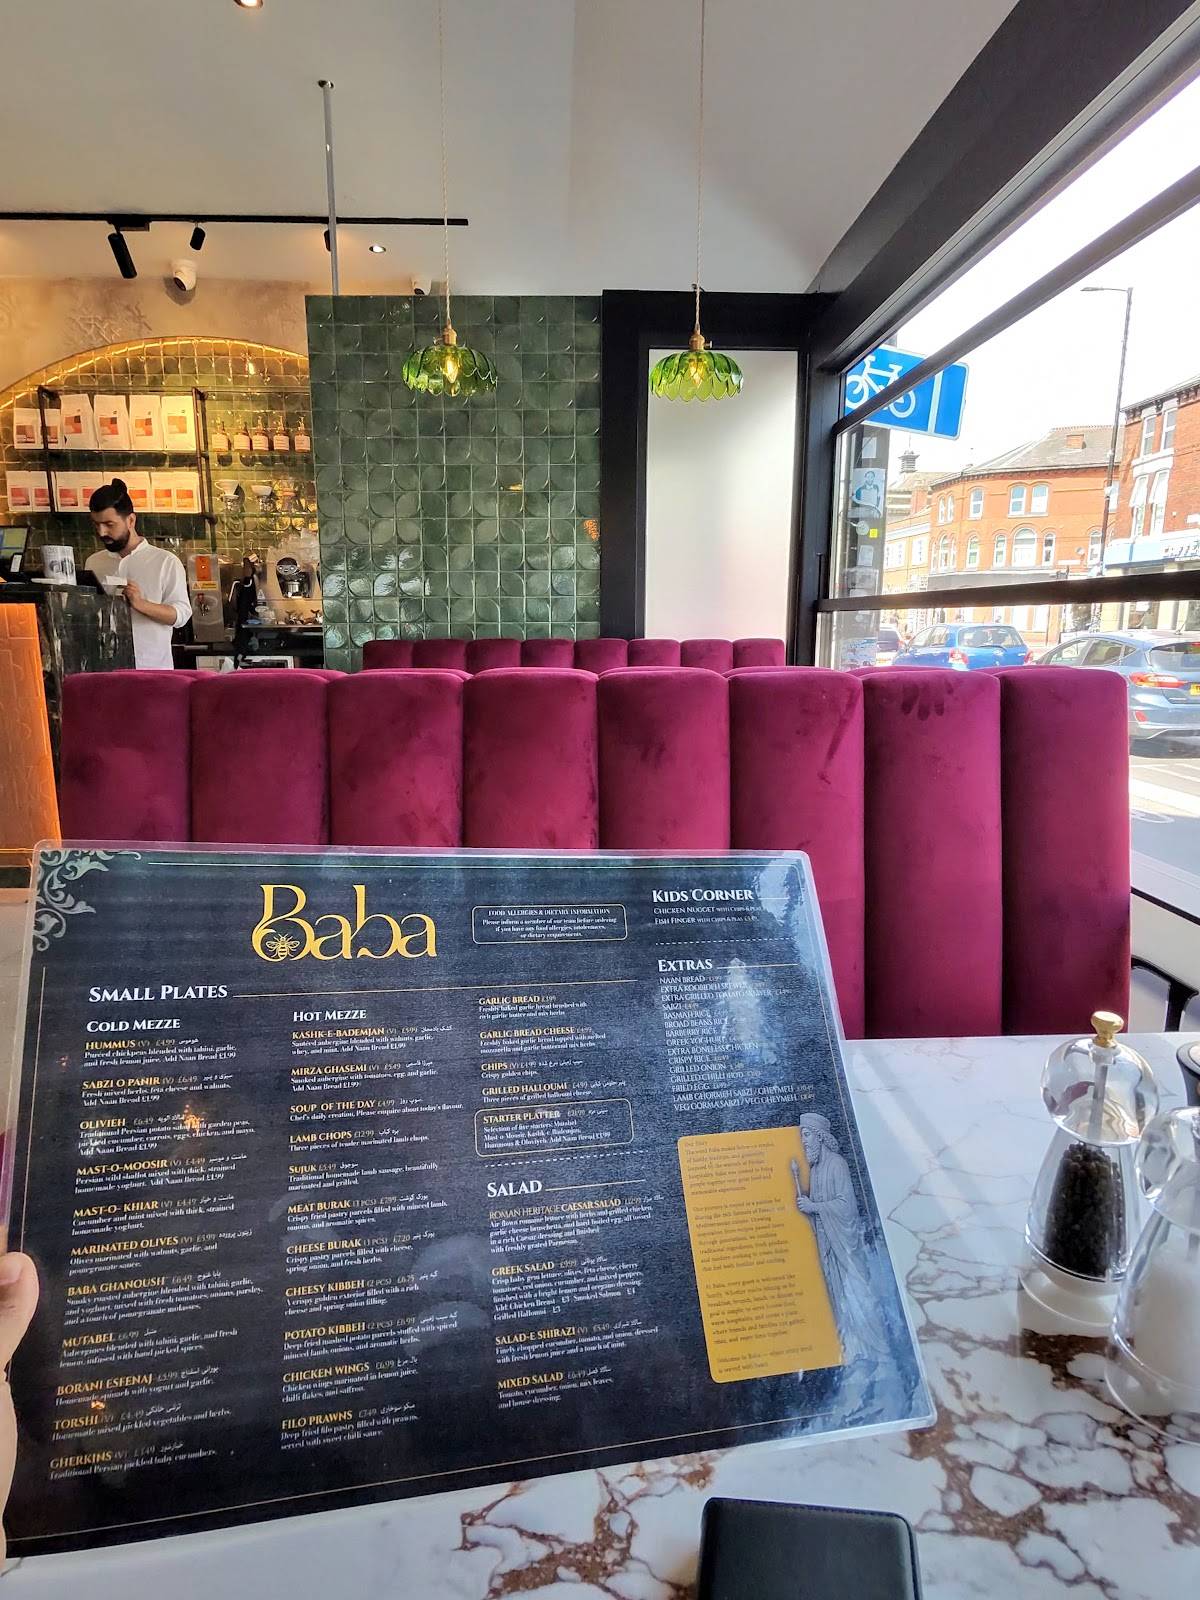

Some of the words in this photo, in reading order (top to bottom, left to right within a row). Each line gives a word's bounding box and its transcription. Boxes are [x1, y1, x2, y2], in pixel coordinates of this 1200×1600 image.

[652, 890, 688, 902] KIDS
[692, 889, 754, 901] CORNER
[251, 884, 437, 961] Baba
[658, 959, 712, 972] EXTRAS
[88, 986, 154, 1002] SMALL
[160, 984, 227, 999] PLATES
[293, 1012, 322, 1022] HOT
[325, 1010, 366, 1020] MEZZE
[87, 1021, 129, 1032] COLD
[133, 1019, 180, 1029] MEZZE
[480, 1031, 512, 1039] GARLIC
[514, 1029, 542, 1037] BREAD
[543, 1027, 575, 1035] CHEESE
[292, 1028, 384, 1039] KASHK-E-BADEMJAN
[85, 1040, 135, 1049] HUMMUS
[291, 1065, 322, 1076] MIRZA
[325, 1064, 367, 1074] GHASEMI
[481, 1063, 507, 1071] CHIPS
[83, 1080, 113, 1090] SABZI
[116, 1079, 125, 1087] O
[128, 1077, 160, 1086] PANIR
[482, 1086, 520, 1096] GRILLED
[521, 1082, 567, 1093] HALLOUMI
[290, 1104, 317, 1113] SOUP
[321, 1102, 334, 1111] OF
[336, 1101, 354, 1110] THE
[358, 1100, 375, 1108] DAY
[79, 1119, 126, 1130] OLIVIEH
[483, 1113, 522, 1124] STARTER
[523, 1110, 561, 1121] PLATTER
[290, 1134, 317, 1143] LAMB
[319, 1131, 352, 1141] CHOPS
[76, 1159, 168, 1176] MAST-O-MOOSIR
[289, 1163, 317, 1174] SUJUK
[487, 1180, 542, 1198] SALAD
[73, 1206, 121, 1218] MAST-O-
[123, 1201, 158, 1212] KHIAR
[288, 1203, 315, 1214] MEAT
[317, 1200, 351, 1211] BURAK
[594, 1198, 622, 1209] SALAD
[70, 1240, 138, 1256] MARINATED
[140, 1236, 179, 1249] OLIVES
[286, 1242, 326, 1255] CHEESE
[328, 1239, 362, 1250] BURAK
[492, 1264, 523, 1277] GREEK
[525, 1262, 555, 1272] SALAD
[68, 1286, 97, 1296] BABA
[100, 1276, 165, 1293] GHANOUSH
[285, 1285, 325, 1297] CHEESY
[328, 1280, 365, 1292] KIBBEH
[284, 1327, 325, 1341] POTATO
[328, 1322, 366, 1335] KIBBEH
[495, 1332, 536, 1345] SALAD-E
[538, 1327, 576, 1339] SHIRAZI
[62, 1332, 114, 1348] MUTABEL
[282, 1367, 332, 1383] CHICKEN
[335, 1362, 370, 1374] WINGS
[57, 1378, 103, 1395] BORANI
[106, 1374, 153, 1389] ESFENAJ
[498, 1376, 531, 1389] MIXED
[532, 1372, 564, 1384] SALAD
[54, 1414, 99, 1430] TORSHI
[281, 1417, 307, 1430] FILO
[309, 1411, 353, 1425] PRAWNS
[50, 1450, 112, 1469] GHERKINS
